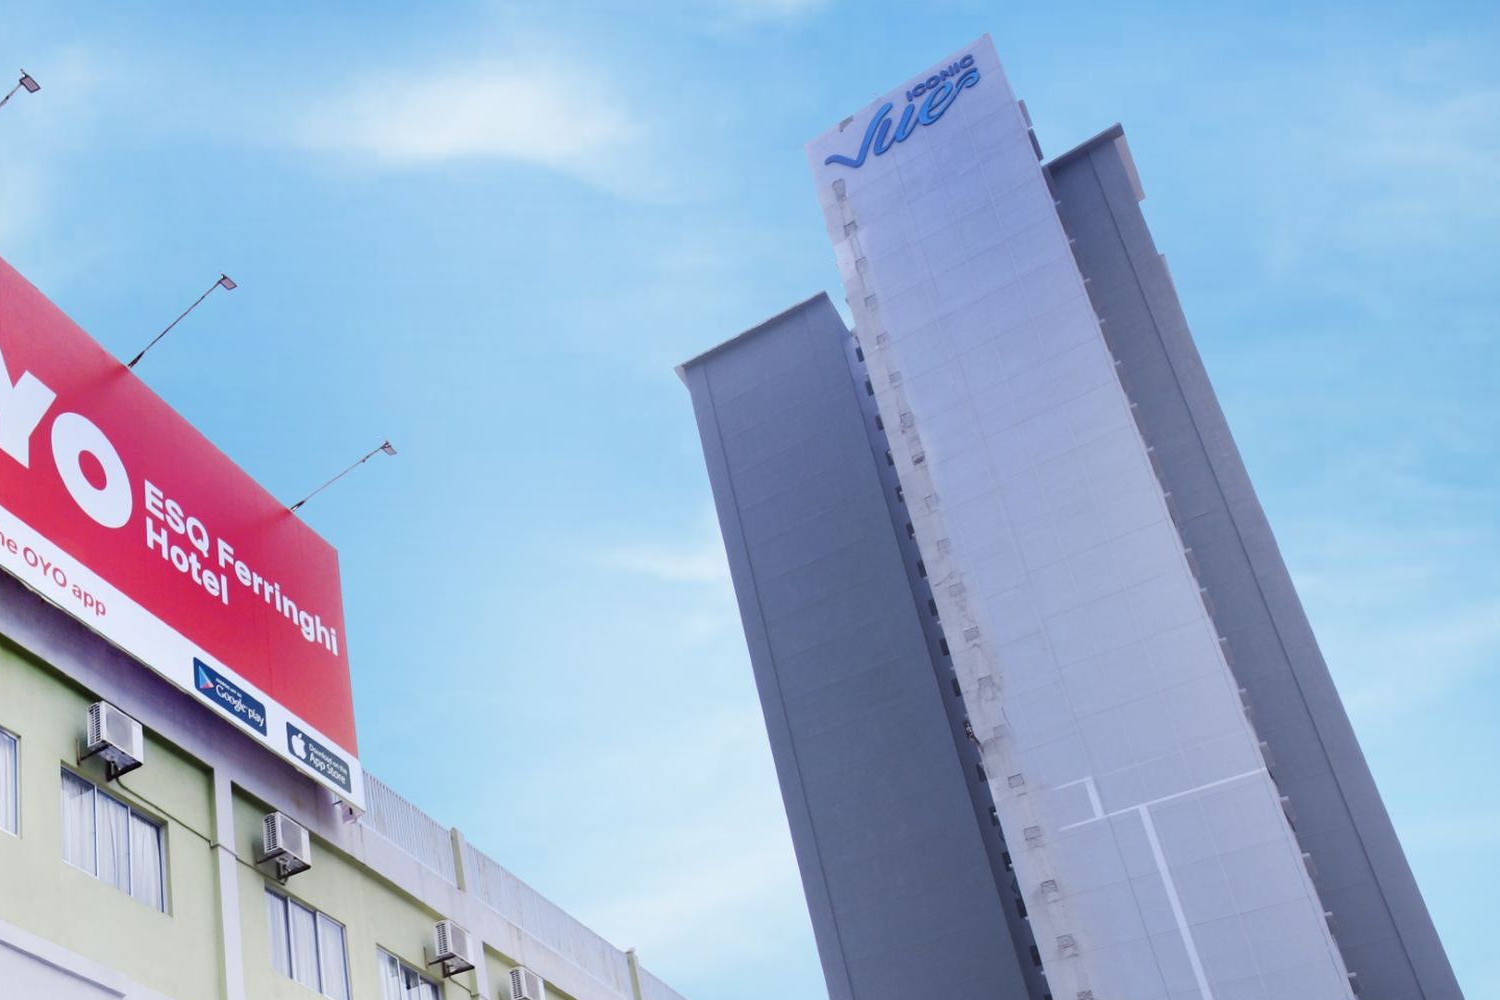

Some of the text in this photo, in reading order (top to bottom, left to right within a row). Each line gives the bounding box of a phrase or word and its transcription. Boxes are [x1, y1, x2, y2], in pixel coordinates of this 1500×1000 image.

[905, 54, 975, 102] ICONIC
[22, 546, 67, 588] OYO
[72, 583, 106, 616] app
[145, 479, 338, 656] ESQ Ferringhi
[146, 516, 228, 606] Hotel
[215, 684, 246, 713] Google
[309, 752, 346, 784] App Store
